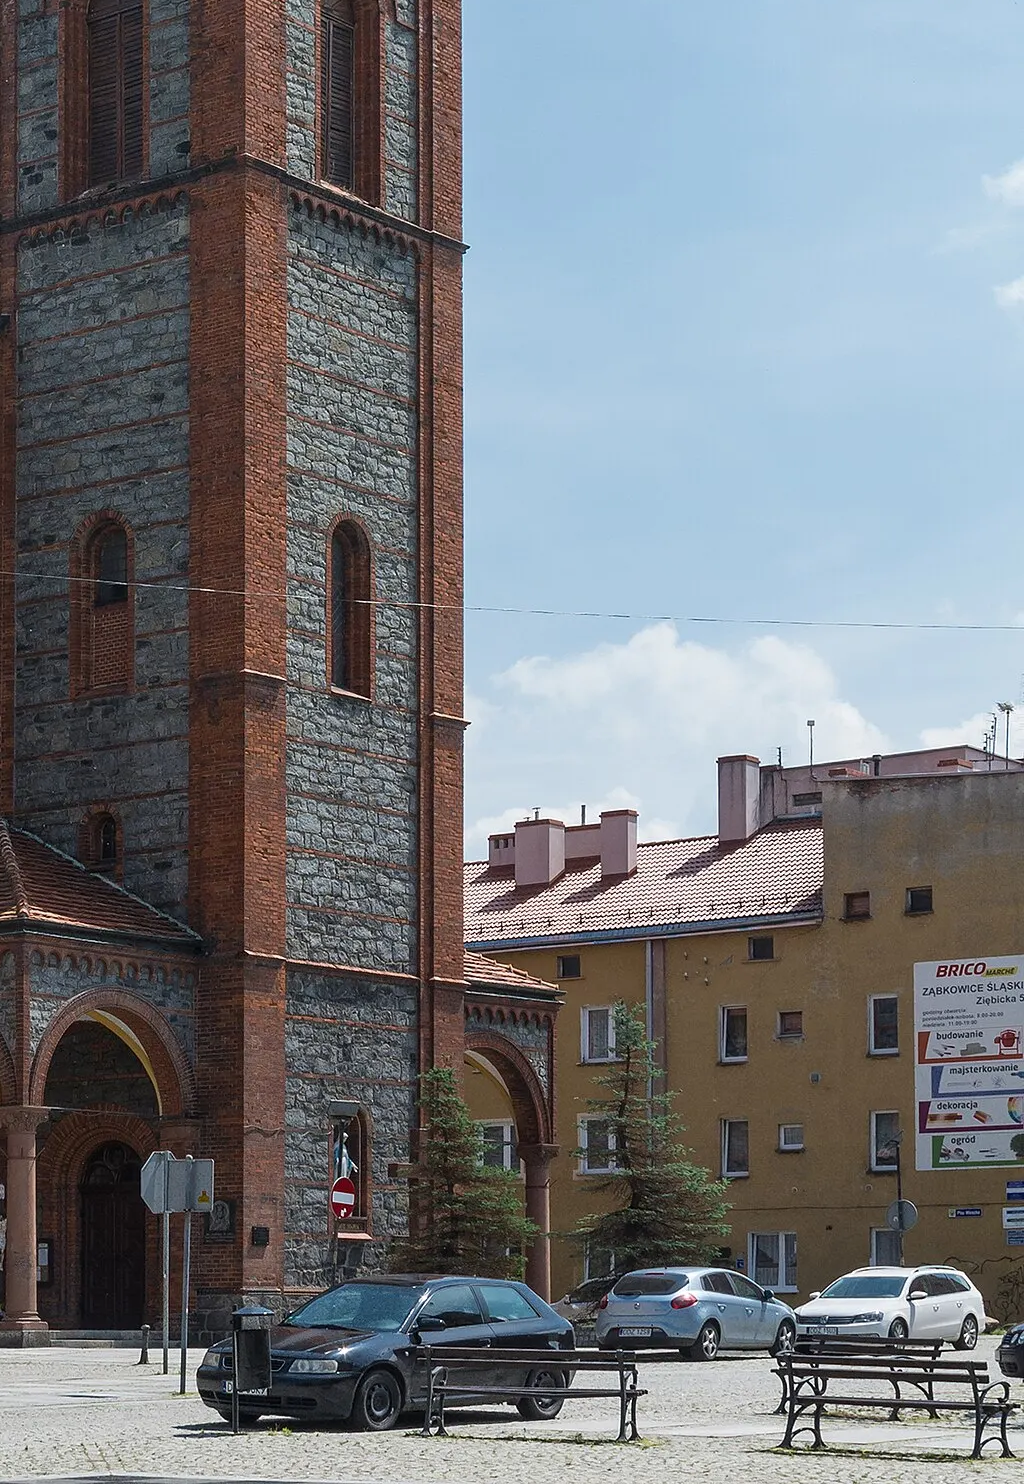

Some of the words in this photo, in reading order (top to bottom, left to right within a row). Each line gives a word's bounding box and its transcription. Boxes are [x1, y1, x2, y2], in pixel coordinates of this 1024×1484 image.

[936, 962, 986, 977] BRICO
[922, 984, 984, 996] ZĄBKOWICE
[976, 995, 1016, 1006] Ziębicka
[936, 1030, 984, 1040] budowanie
[950, 1063, 1018, 1075] majsterkowanie
[937, 1100, 978, 1110] dekoracja
[951, 1136, 976, 1145] ogród
